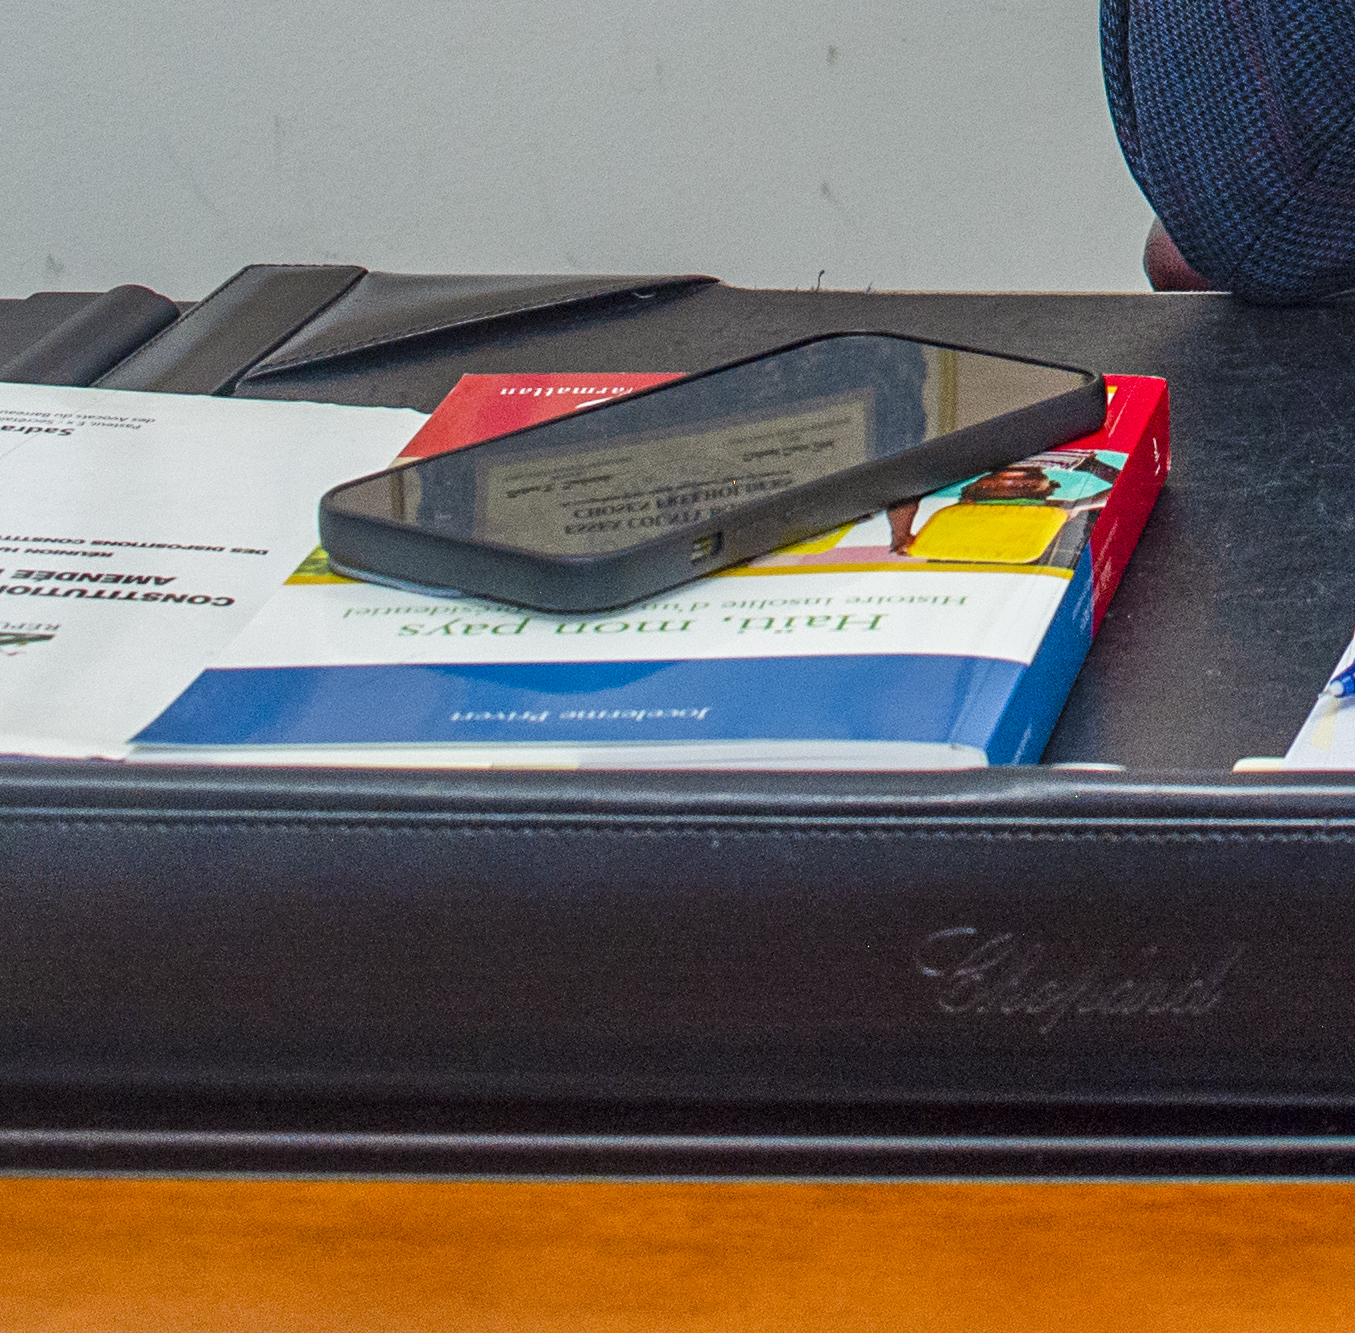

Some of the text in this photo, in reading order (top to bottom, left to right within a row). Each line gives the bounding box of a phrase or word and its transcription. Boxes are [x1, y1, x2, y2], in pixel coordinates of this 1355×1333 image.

[0, 535, 86, 545] CONSTIT
[230, 547, 269, 556] DES
[11, 568, 178, 586] AMENDÉE
[720, 597, 834, 610] insolite
[845, 594, 970, 608] Histoire
[397, 612, 889, 638] Haïti, mon pays
[450, 706, 711, 723] Jocelerme Privert
